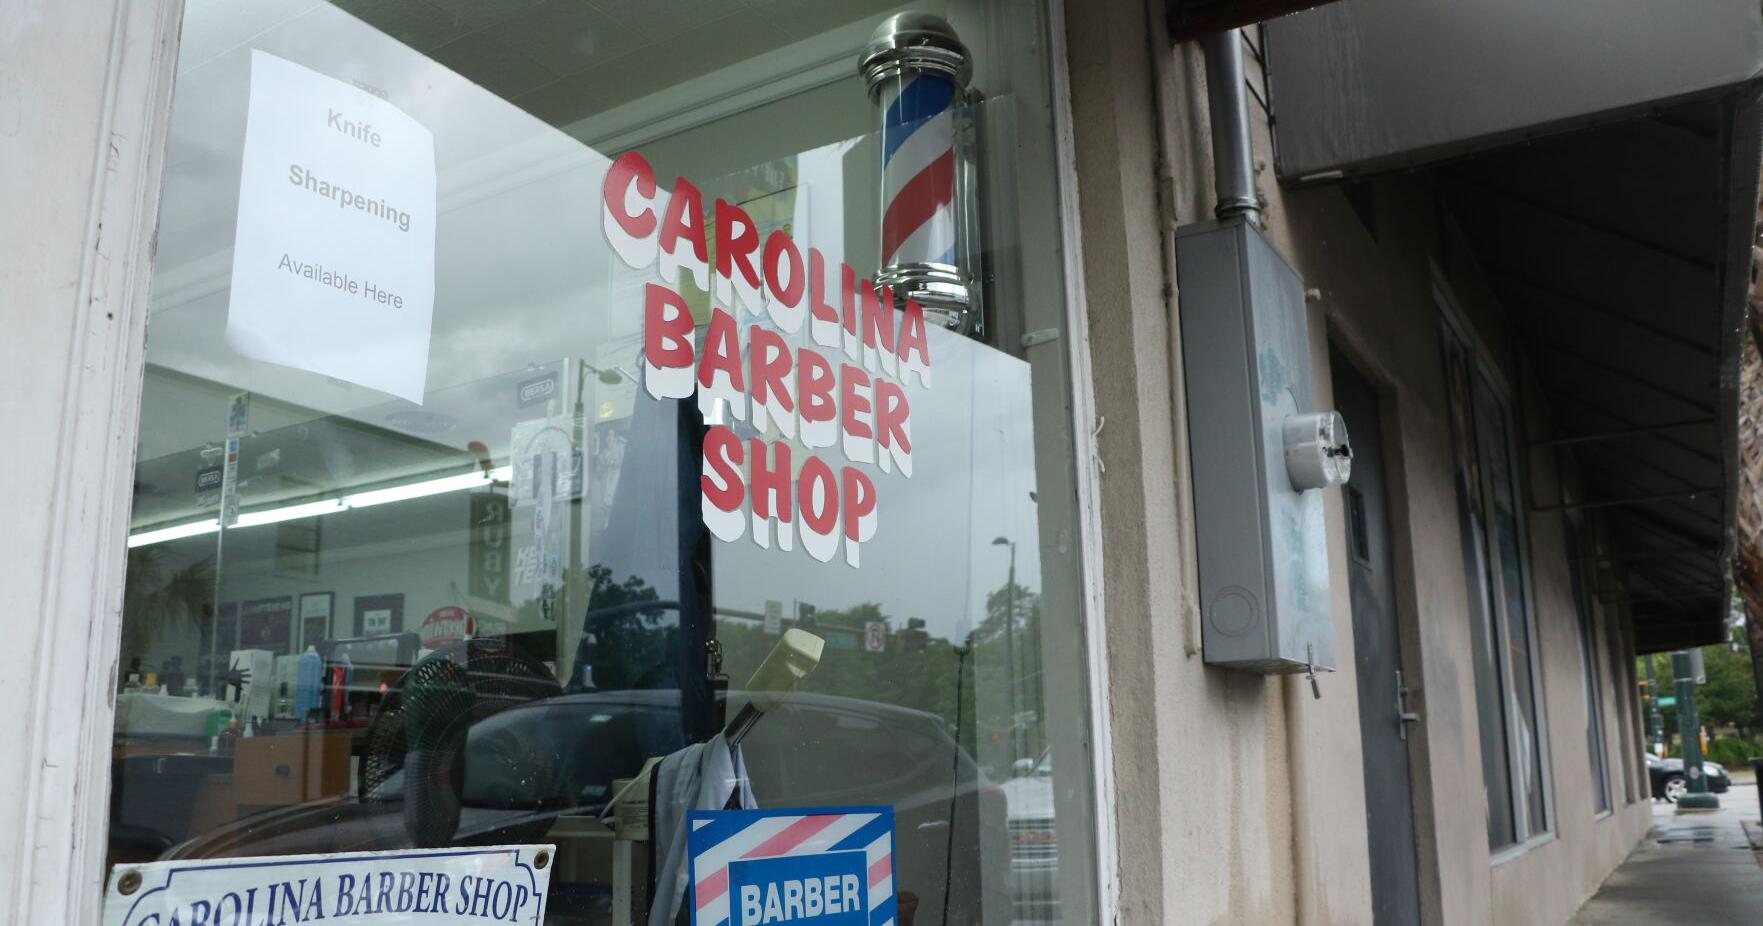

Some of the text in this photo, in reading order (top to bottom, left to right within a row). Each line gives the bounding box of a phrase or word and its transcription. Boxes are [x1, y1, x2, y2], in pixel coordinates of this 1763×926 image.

[327, 108, 382, 147] Knife
[288, 164, 411, 232] Sharpening
[278, 253, 403, 309] Available Here
[603, 151, 931, 389] CAROLINA
[645, 283, 912, 479] BARBER
[701, 425, 877, 569] SHOP
[333, 872, 450, 917] BARBER
[456, 875, 529, 922] SHOP
[741, 874, 860, 926] BARBER
